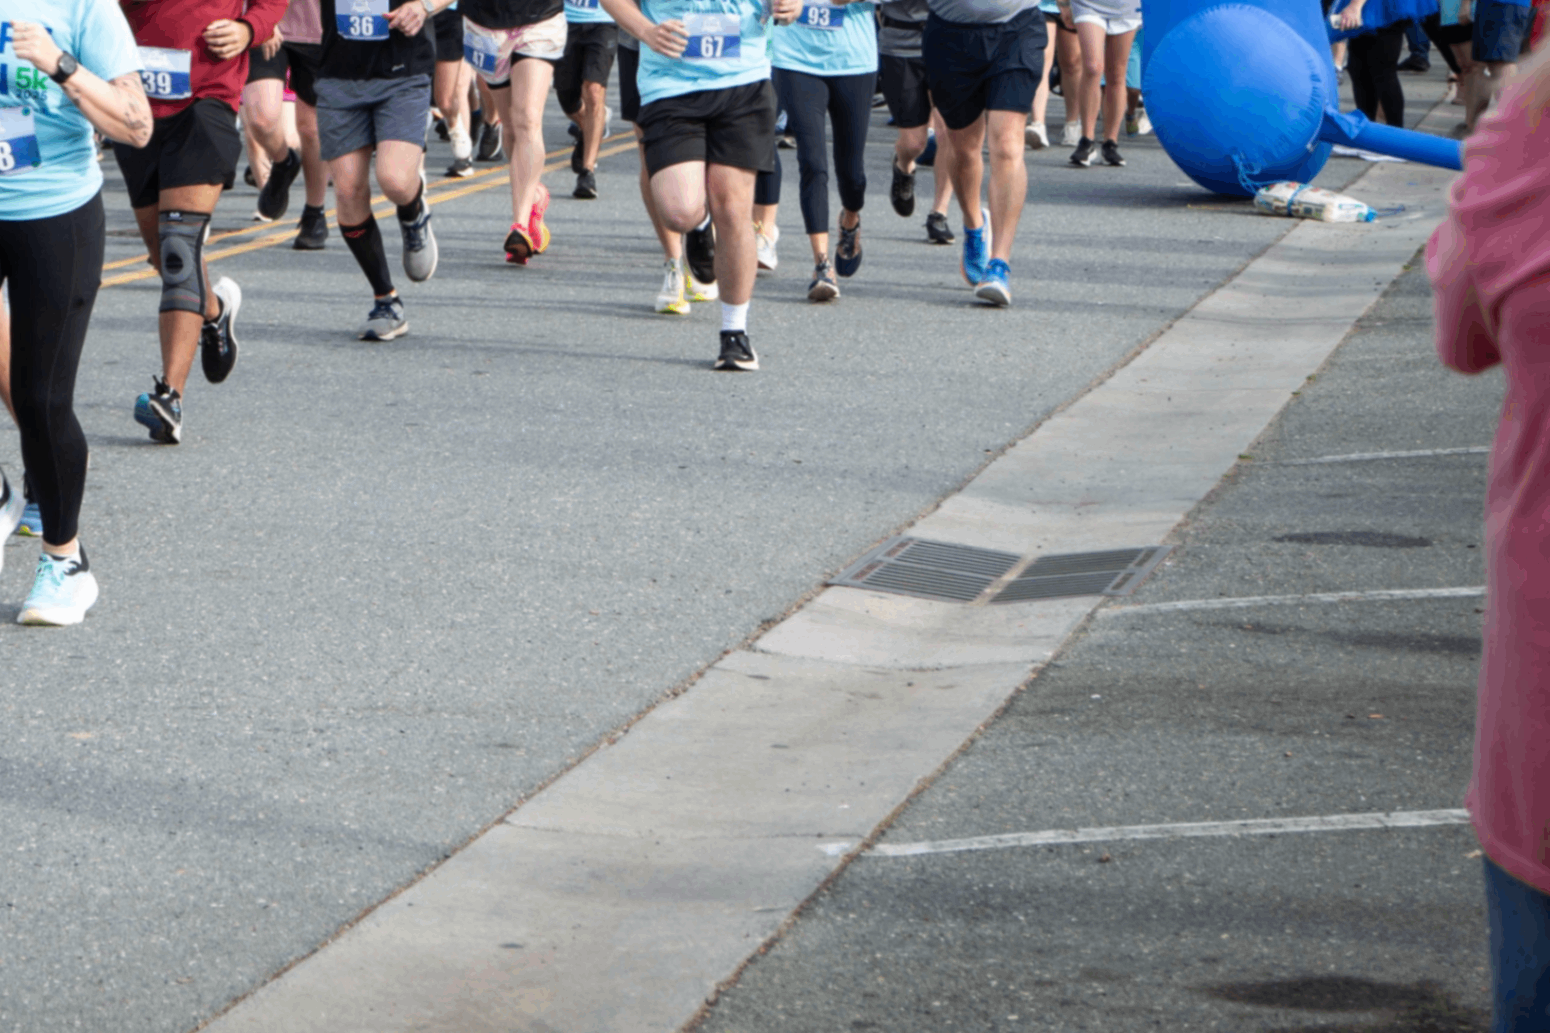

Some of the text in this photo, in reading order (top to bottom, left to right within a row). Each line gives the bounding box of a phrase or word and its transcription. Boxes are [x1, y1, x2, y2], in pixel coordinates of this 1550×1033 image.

[350, 15, 374, 36] 36
[808, 7, 831, 26] 93
[701, 35, 725, 58] 67
[472, 49, 485, 68] 47
[141, 71, 172, 95] 39
[15, 88, 48, 101] 2025
